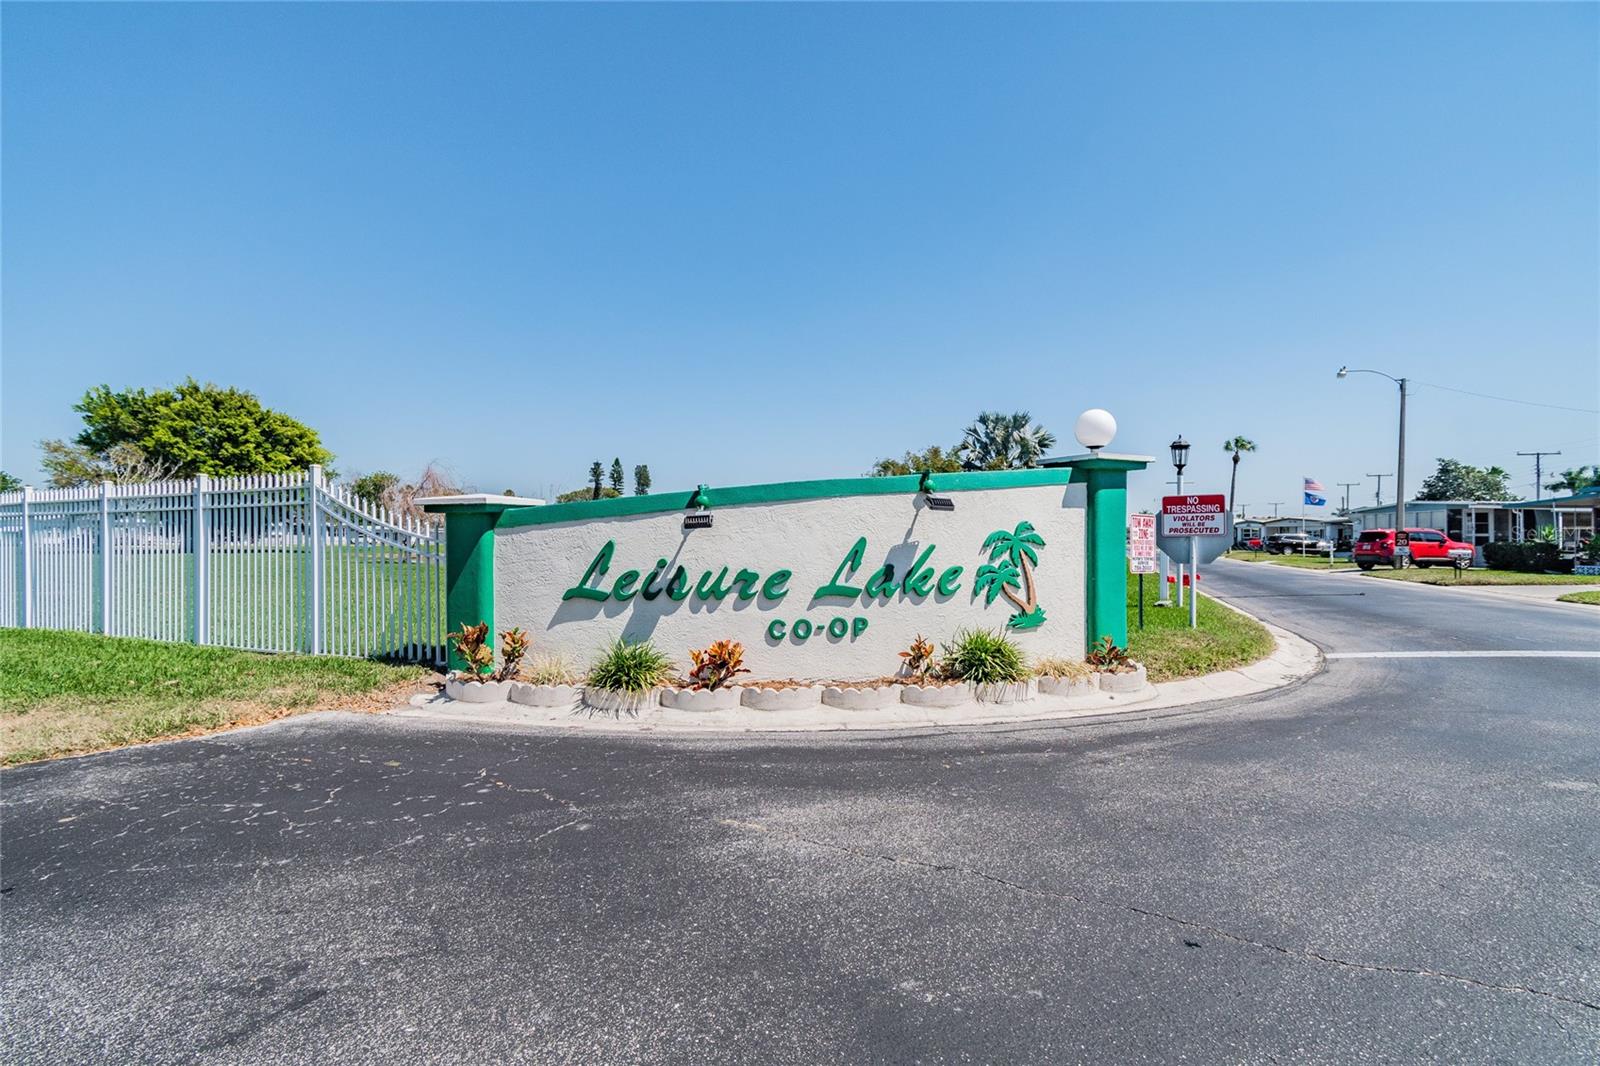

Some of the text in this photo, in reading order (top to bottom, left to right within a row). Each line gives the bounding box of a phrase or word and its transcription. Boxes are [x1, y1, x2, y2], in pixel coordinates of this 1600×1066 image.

[1187, 496, 1199, 505] NO
[1167, 504, 1220, 514] TRESPASSING
[1173, 514, 1216, 522] VIOLATORS
[1396, 538, 1408, 546] 20
[561, 536, 964, 602] Leisure Lake
[768, 616, 869, 641] CO-OP
